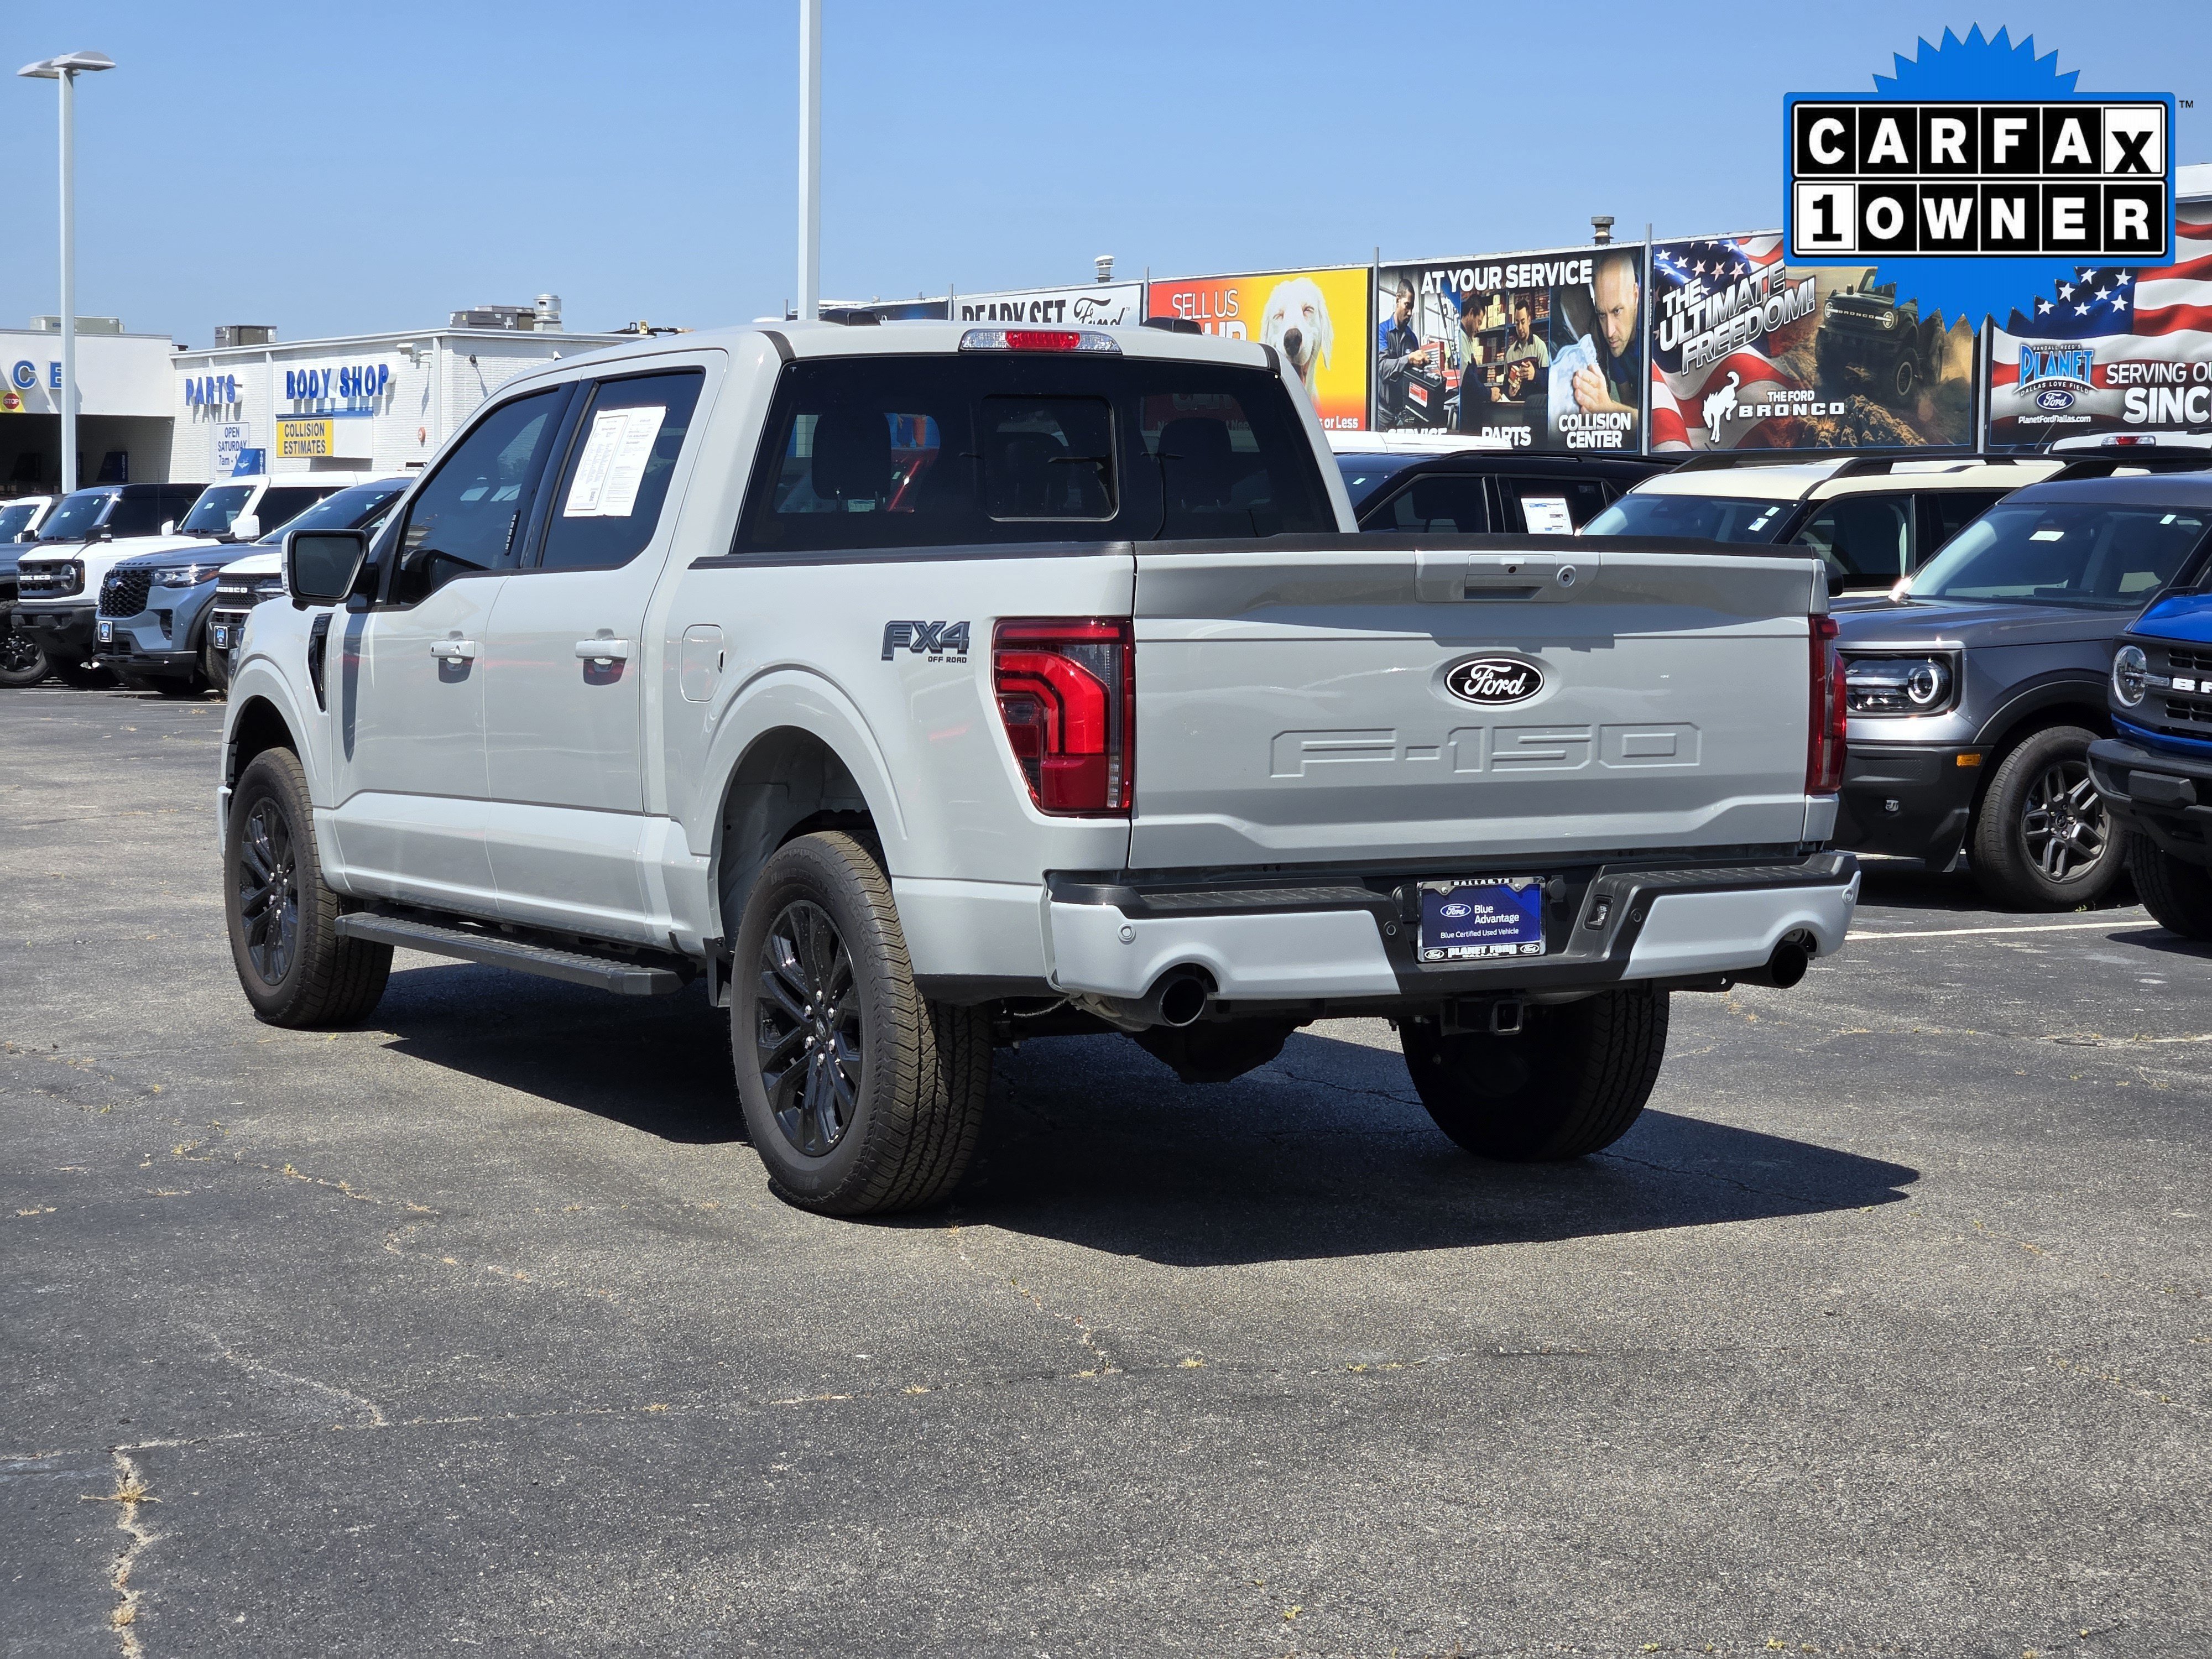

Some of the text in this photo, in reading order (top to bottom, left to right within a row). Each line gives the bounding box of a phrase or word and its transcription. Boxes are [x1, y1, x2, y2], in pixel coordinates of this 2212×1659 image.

[1421, 259, 1592, 295] AT YOUR SERVICE
[1172, 289, 1238, 319] SELL US
[1660, 259, 1787, 352] ULTIMATE
[1663, 278, 1702, 317] THE
[1682, 276, 1816, 375] FREEDOM!
[2020, 345, 2094, 388] PLANET
[2106, 362, 2212, 384] SERVING O
[186, 374, 236, 406] PARTS
[286, 364, 389, 399] BODY SHOP
[2021, 382, 2046, 397] DALLAS
[2069, 383, 2089, 394] FIELD
[1767, 390, 1815, 402] THE FORD
[2122, 386, 2212, 424] SINC
[1739, 402, 1845, 418] BRONCO
[2018, 415, 2091, 424] PlanetFordDallas.com
[285, 422, 325, 437] COLLISION
[1324, 418, 1334, 429] or
[1336, 415, 1358, 429] Less
[1558, 413, 1631, 432] COLLISION
[225, 426, 240, 438] OPEN
[1481, 426, 1531, 446] PARTS
[1567, 430, 1623, 449] CENTER
[218, 440, 247, 452] SATURDAY
[284, 440, 326, 454] ESTIMATES
[881, 620, 971, 660] FX4
[1270, 722, 1701, 778] F-150
[1474, 905, 1494, 914] Blue
[1474, 914, 1520, 924] Advantage
[1455, 928, 1480, 938] Certified
[1482, 927, 1497, 936] Used
[1498, 927, 1519, 935] Vehicle
[1448, 946, 1487, 958] PLANET
[1490, 944, 1517, 954] FORD
